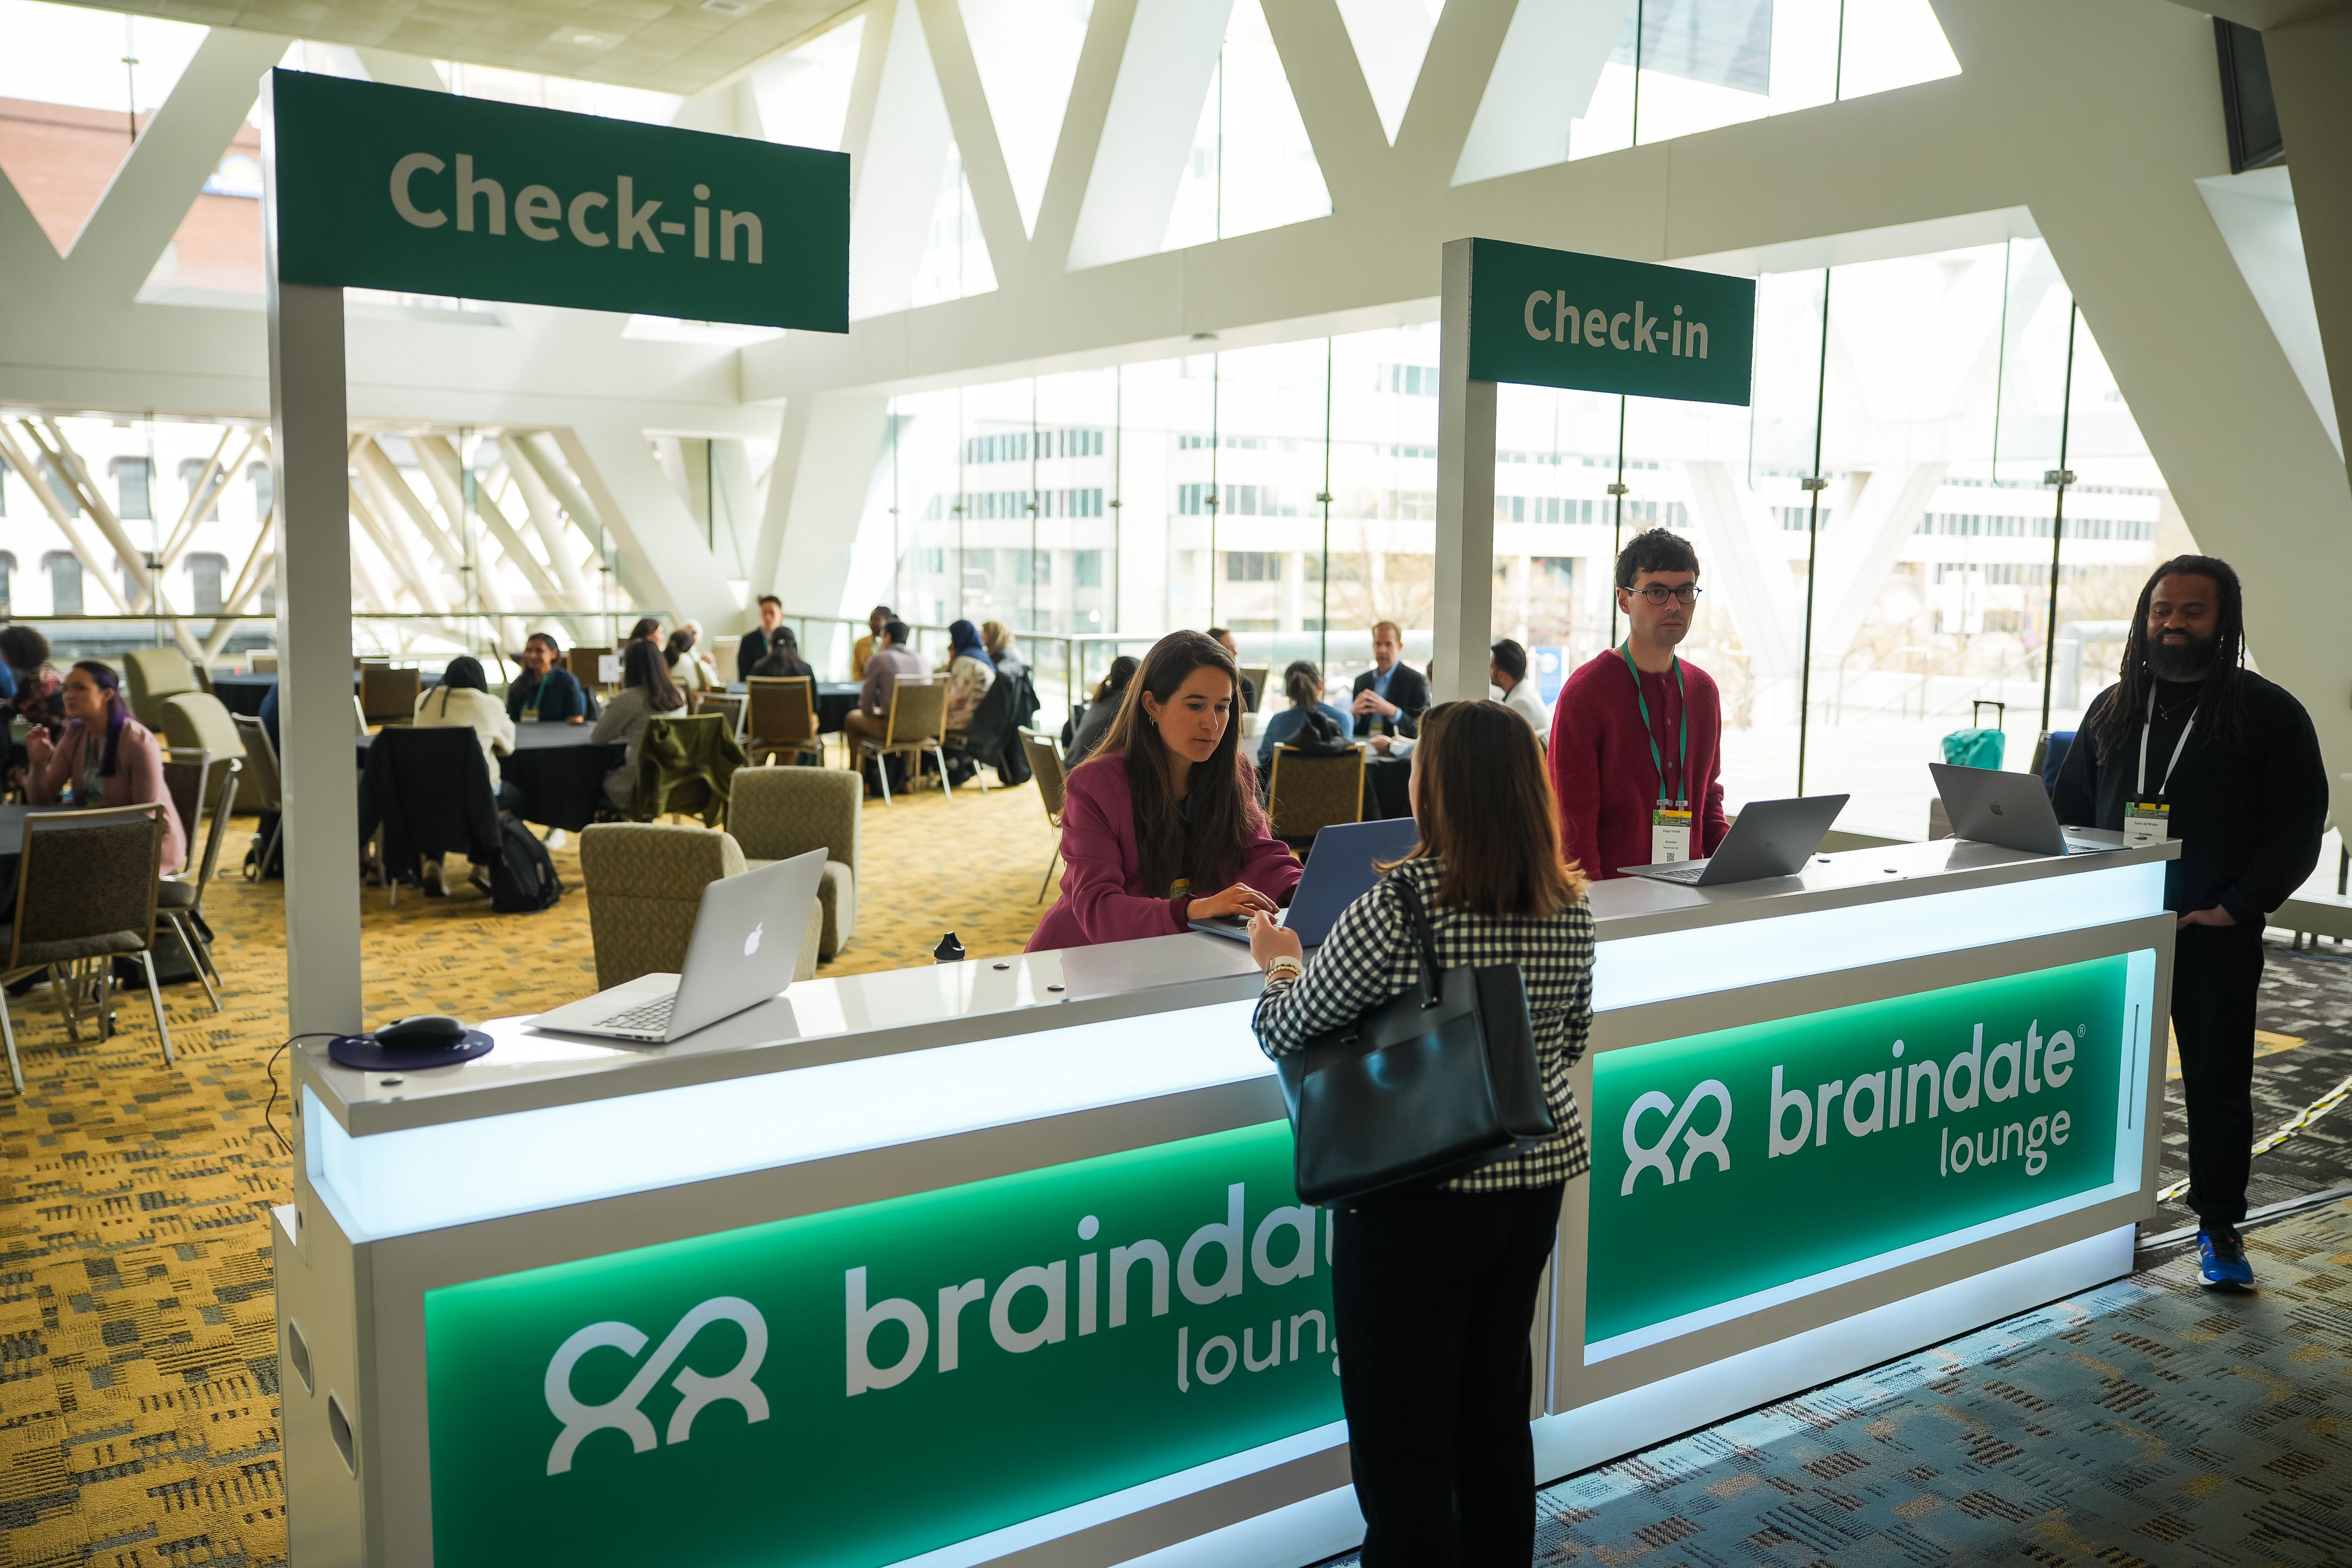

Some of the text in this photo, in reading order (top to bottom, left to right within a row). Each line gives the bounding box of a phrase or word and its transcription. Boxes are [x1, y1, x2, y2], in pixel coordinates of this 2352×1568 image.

[389, 152, 763, 265] Check-in
[1524, 290, 1709, 359] Check-in
[1940, 1110, 2070, 1176] lounge
[845, 1182, 1334, 1398] brainda
[1178, 1309, 1340, 1393] loun
